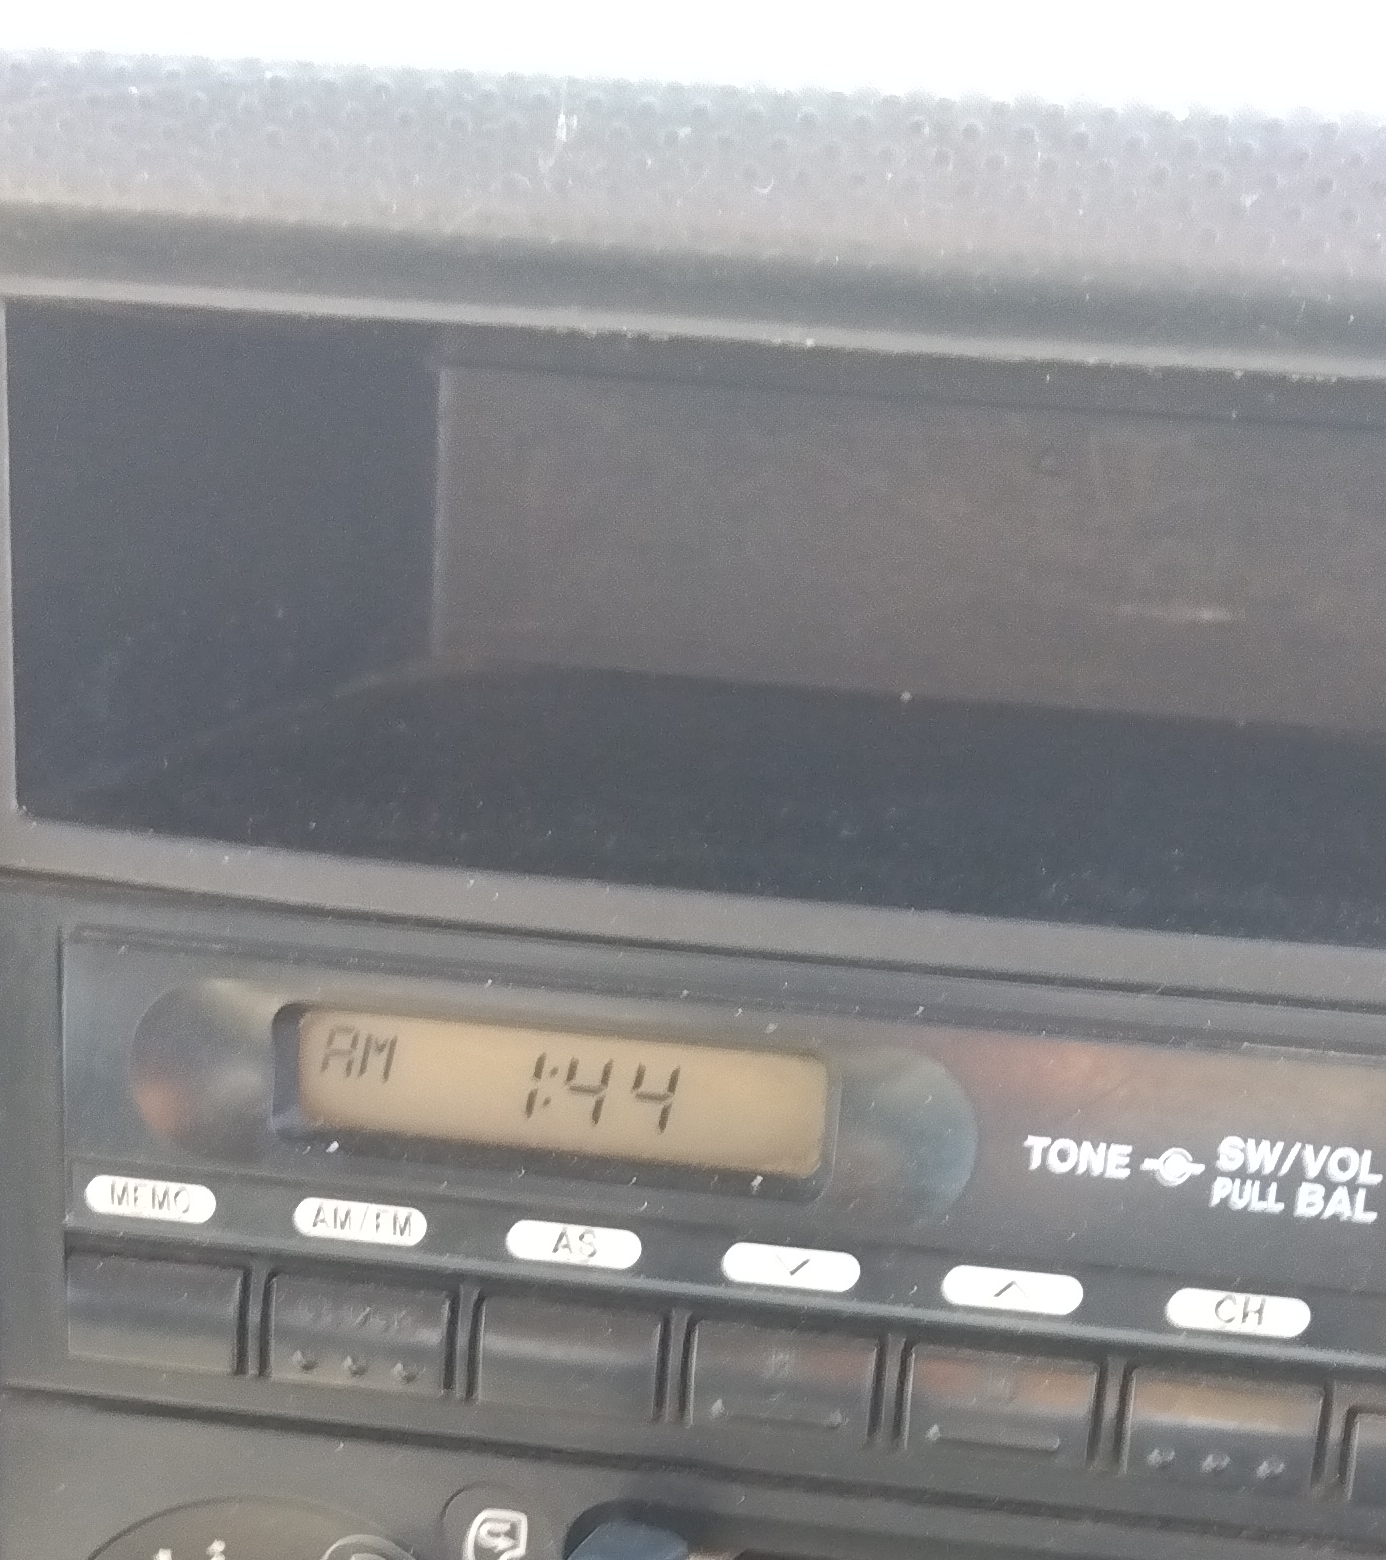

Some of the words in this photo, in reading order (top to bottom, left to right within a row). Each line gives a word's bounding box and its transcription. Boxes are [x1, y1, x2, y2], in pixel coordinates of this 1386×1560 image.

[320, 1024, 398, 1083] AM
[524, 1051, 682, 1135] 1:44
[1023, 1134, 1133, 1180] TONE
[1216, 1135, 1383, 1186] SW/VOL
[109, 1180, 190, 1214] MEMO
[1209, 1176, 1284, 1214] PULL
[1294, 1181, 1378, 1224] BAL
[312, 1202, 412, 1237] AM/FM
[551, 1226, 598, 1262] AS
[1214, 1294, 1268, 1327] CH
